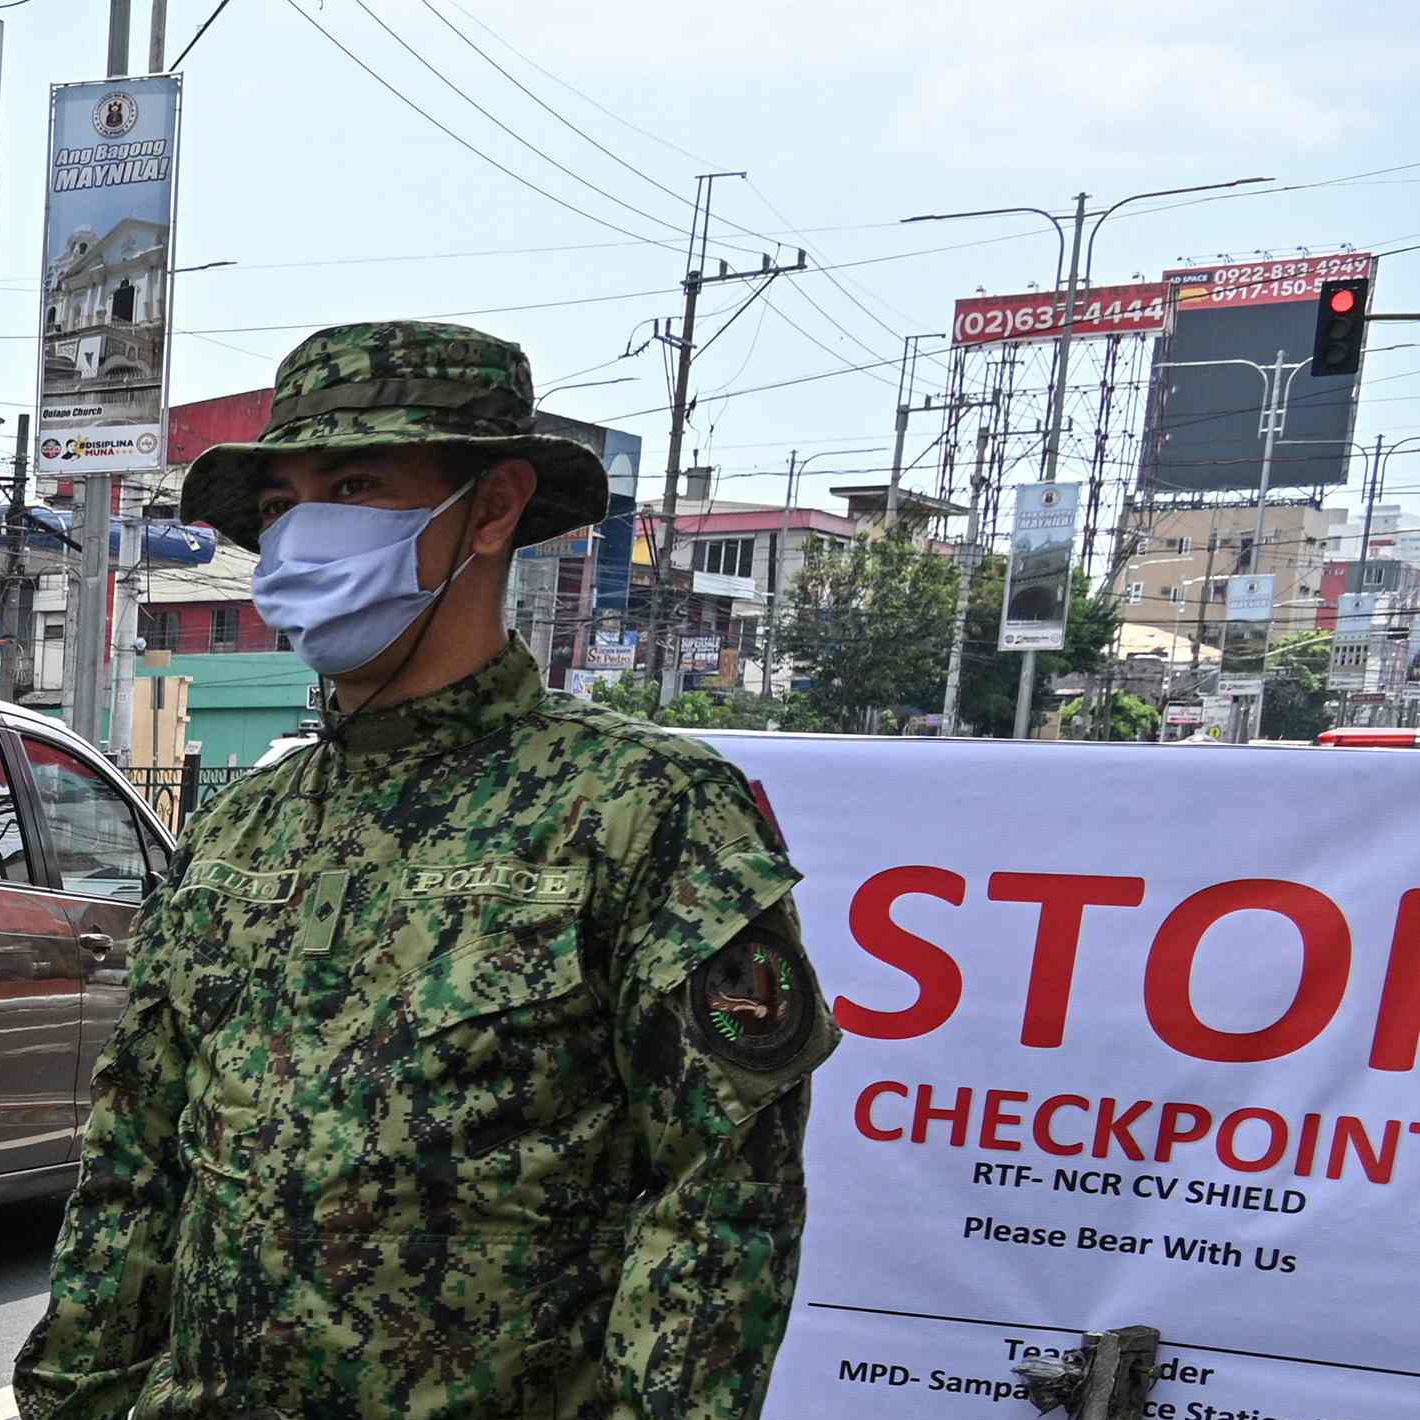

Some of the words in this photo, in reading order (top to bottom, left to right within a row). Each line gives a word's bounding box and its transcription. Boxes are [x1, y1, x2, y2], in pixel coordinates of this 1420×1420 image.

[55, 148, 94, 167] Ang
[94, 139, 167, 162] Bagong
[54, 156, 169, 193] MAYNILA!
[1182, 274, 1208, 284] SPACE
[1214, 257, 1367, 285] 0922-833-4949
[1212, 275, 1364, 302] 0917-150-5
[72, 406, 103, 417] Church
[79, 439, 134, 450] #DISIPLINA
[84, 449, 115, 457] MUNA
[411, 865, 570, 895] POLICE
[854, 1080, 1420, 1184] CHECKPOIN
[972, 1162, 1043, 1186] RTF-
[1053, 1168, 1122, 1196] NCR
[1132, 1174, 1179, 1200] CV
[1184, 1179, 1307, 1215] SHIELD
[963, 1216, 1066, 1247] Please
[1077, 1226, 1153, 1256] Bear
[1163, 1235, 1242, 1268] With
[1254, 1247, 1296, 1274] Us
[1004, 1338, 1077, 1361] Tea
[1160, 1357, 1215, 1386] der
[838, 1360, 921, 1387] MPD-
[928, 1369, 1031, 1402] Sampa
